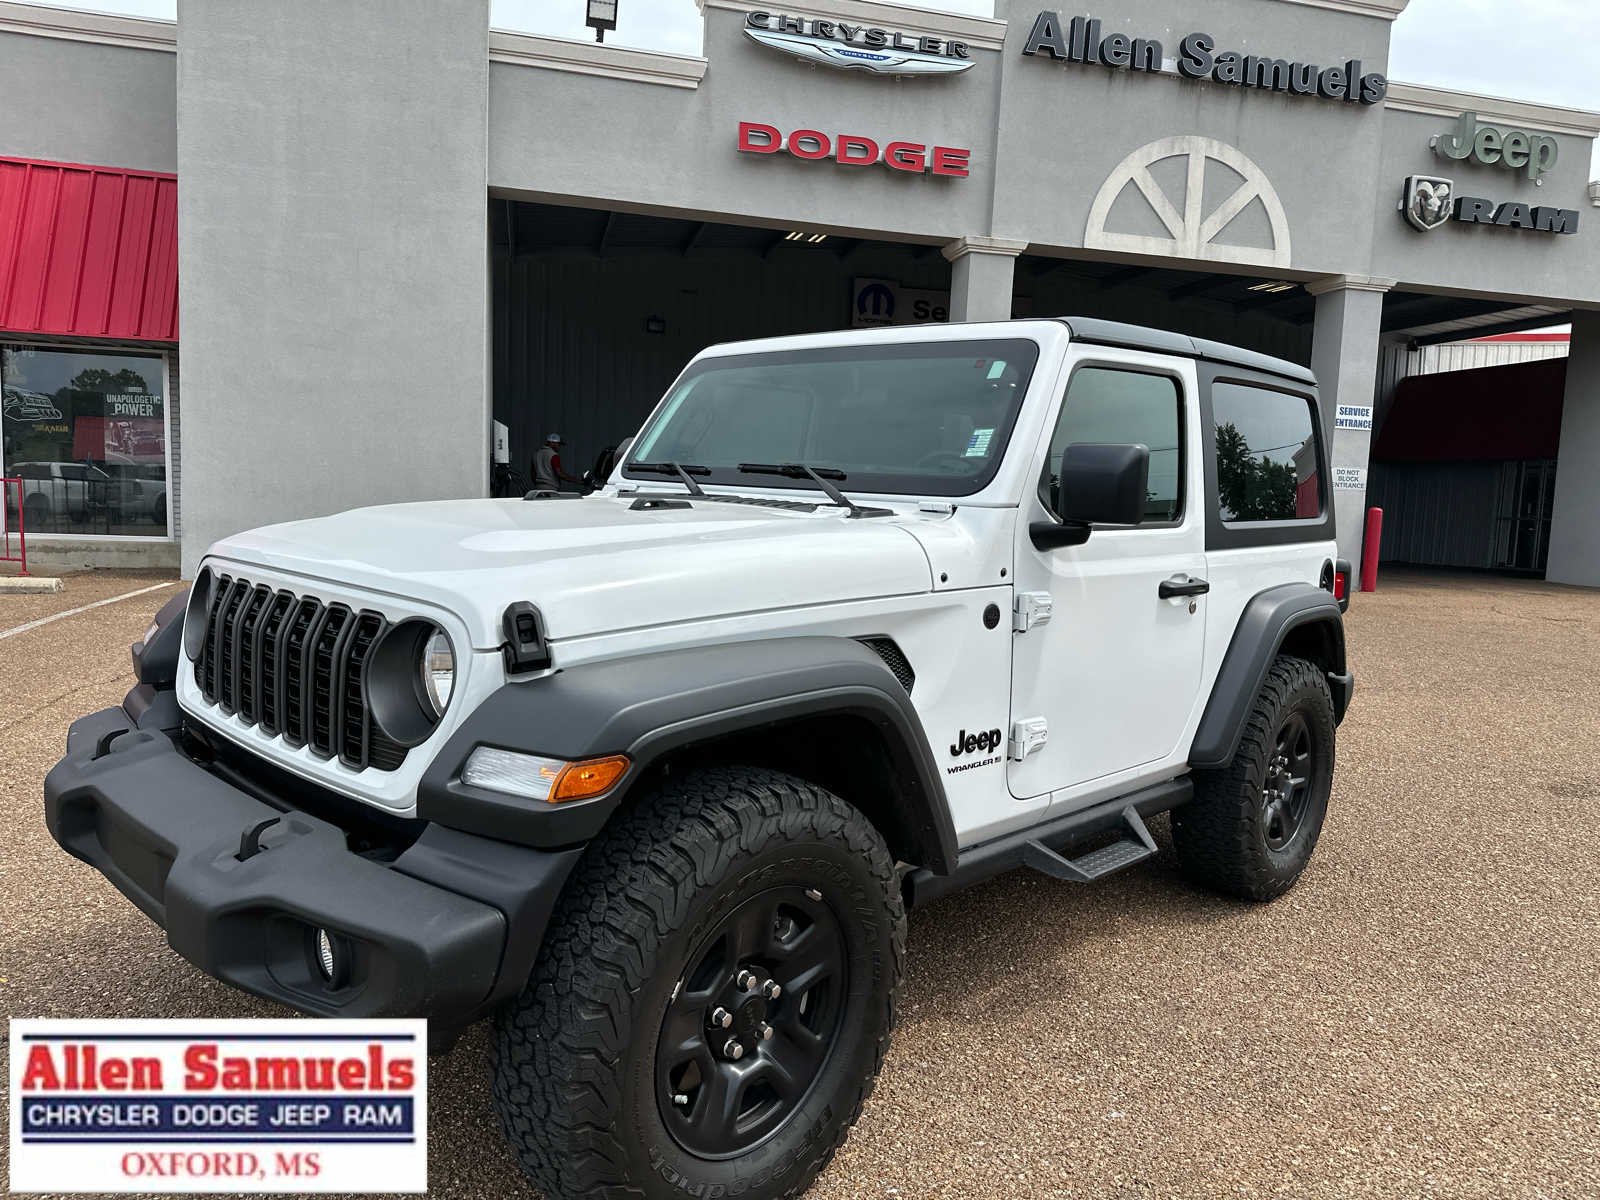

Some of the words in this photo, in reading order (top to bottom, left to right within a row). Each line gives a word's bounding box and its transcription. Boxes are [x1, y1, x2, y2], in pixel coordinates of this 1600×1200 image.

[746, 11, 970, 58] CHRYSLER
[1022, 10, 1163, 72] Allen
[1177, 32, 1386, 104] Samuels
[738, 121, 970, 177] DODGE
[1436, 112, 1558, 179] Jeep
[1453, 196, 1580, 234] RAM
[106, 393, 161, 404] UNAPOLOGETIC
[114, 403, 153, 416] POWER
[1339, 406, 1370, 417] SERVICE
[1335, 418, 1372, 428] ENTRANCE
[950, 728, 1001, 756] Jeep
[947, 758, 994, 774] WRANGLER
